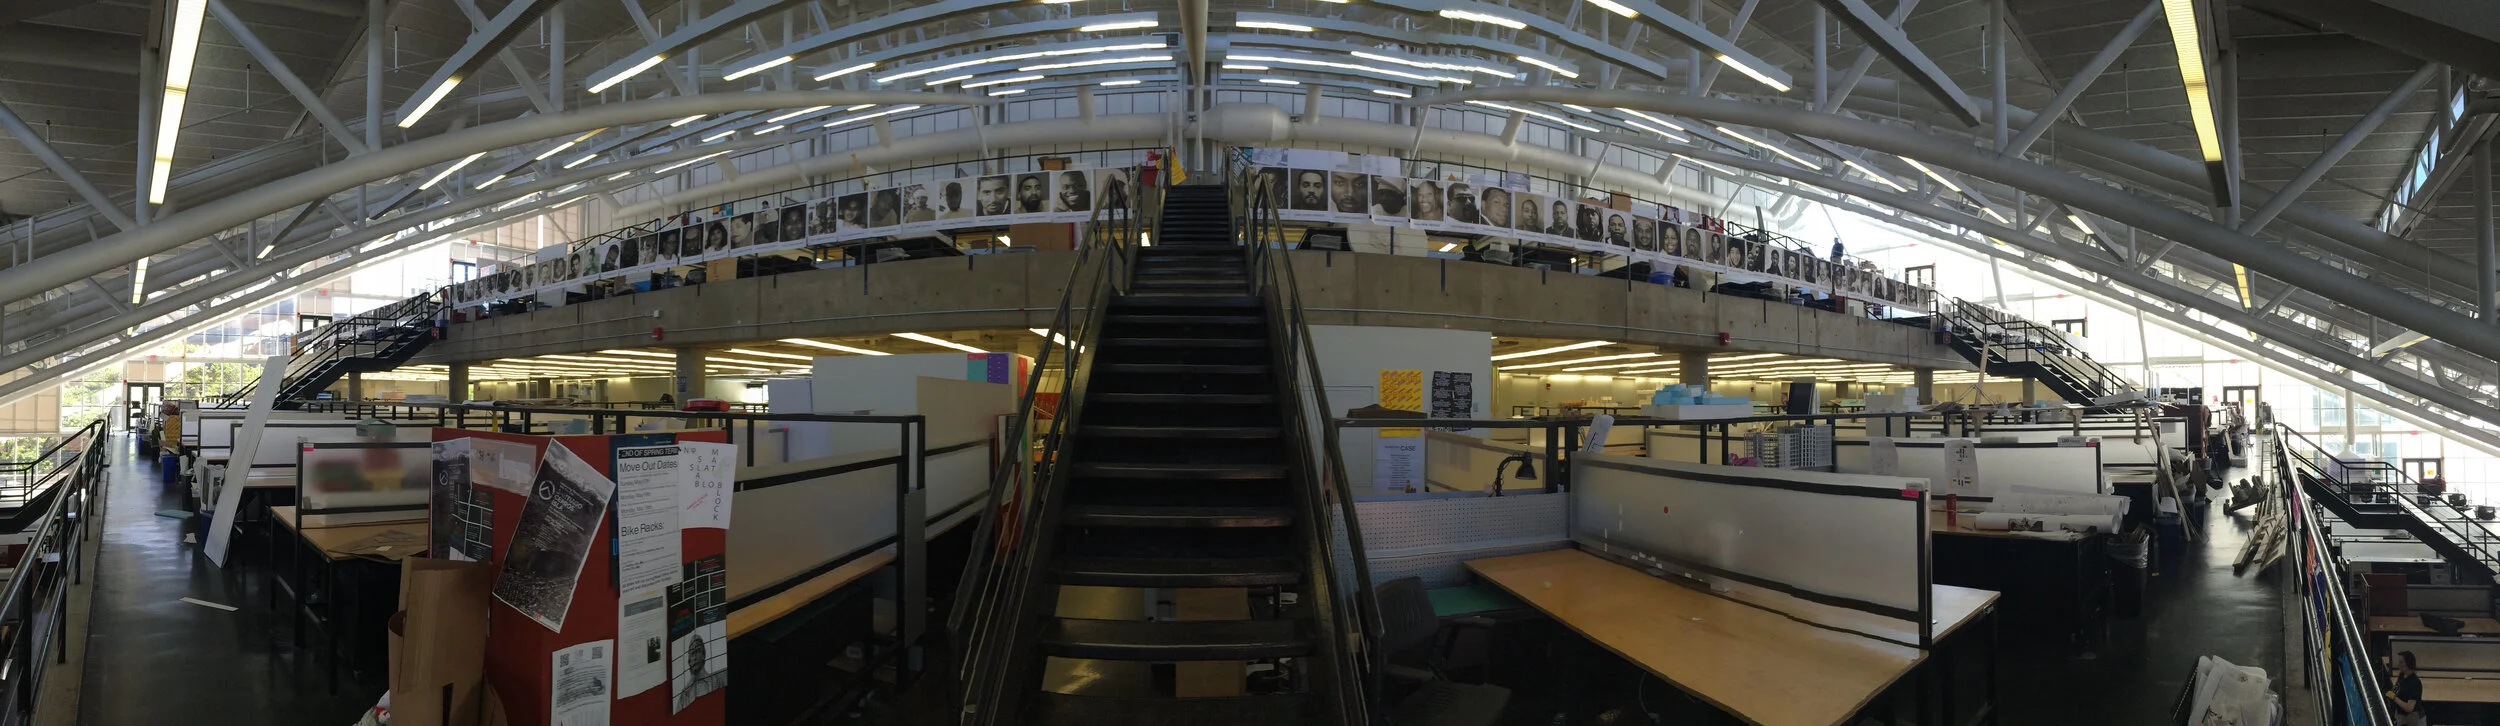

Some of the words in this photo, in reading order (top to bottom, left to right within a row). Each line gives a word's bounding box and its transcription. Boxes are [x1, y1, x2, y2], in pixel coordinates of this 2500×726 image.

[634, 449, 643, 457] OF
[643, 448, 664, 457] SPRING
[620, 462, 640, 472] Move
[642, 461, 656, 471] Out
[656, 460, 678, 470] Dates
[621, 525, 639, 537] Bike
